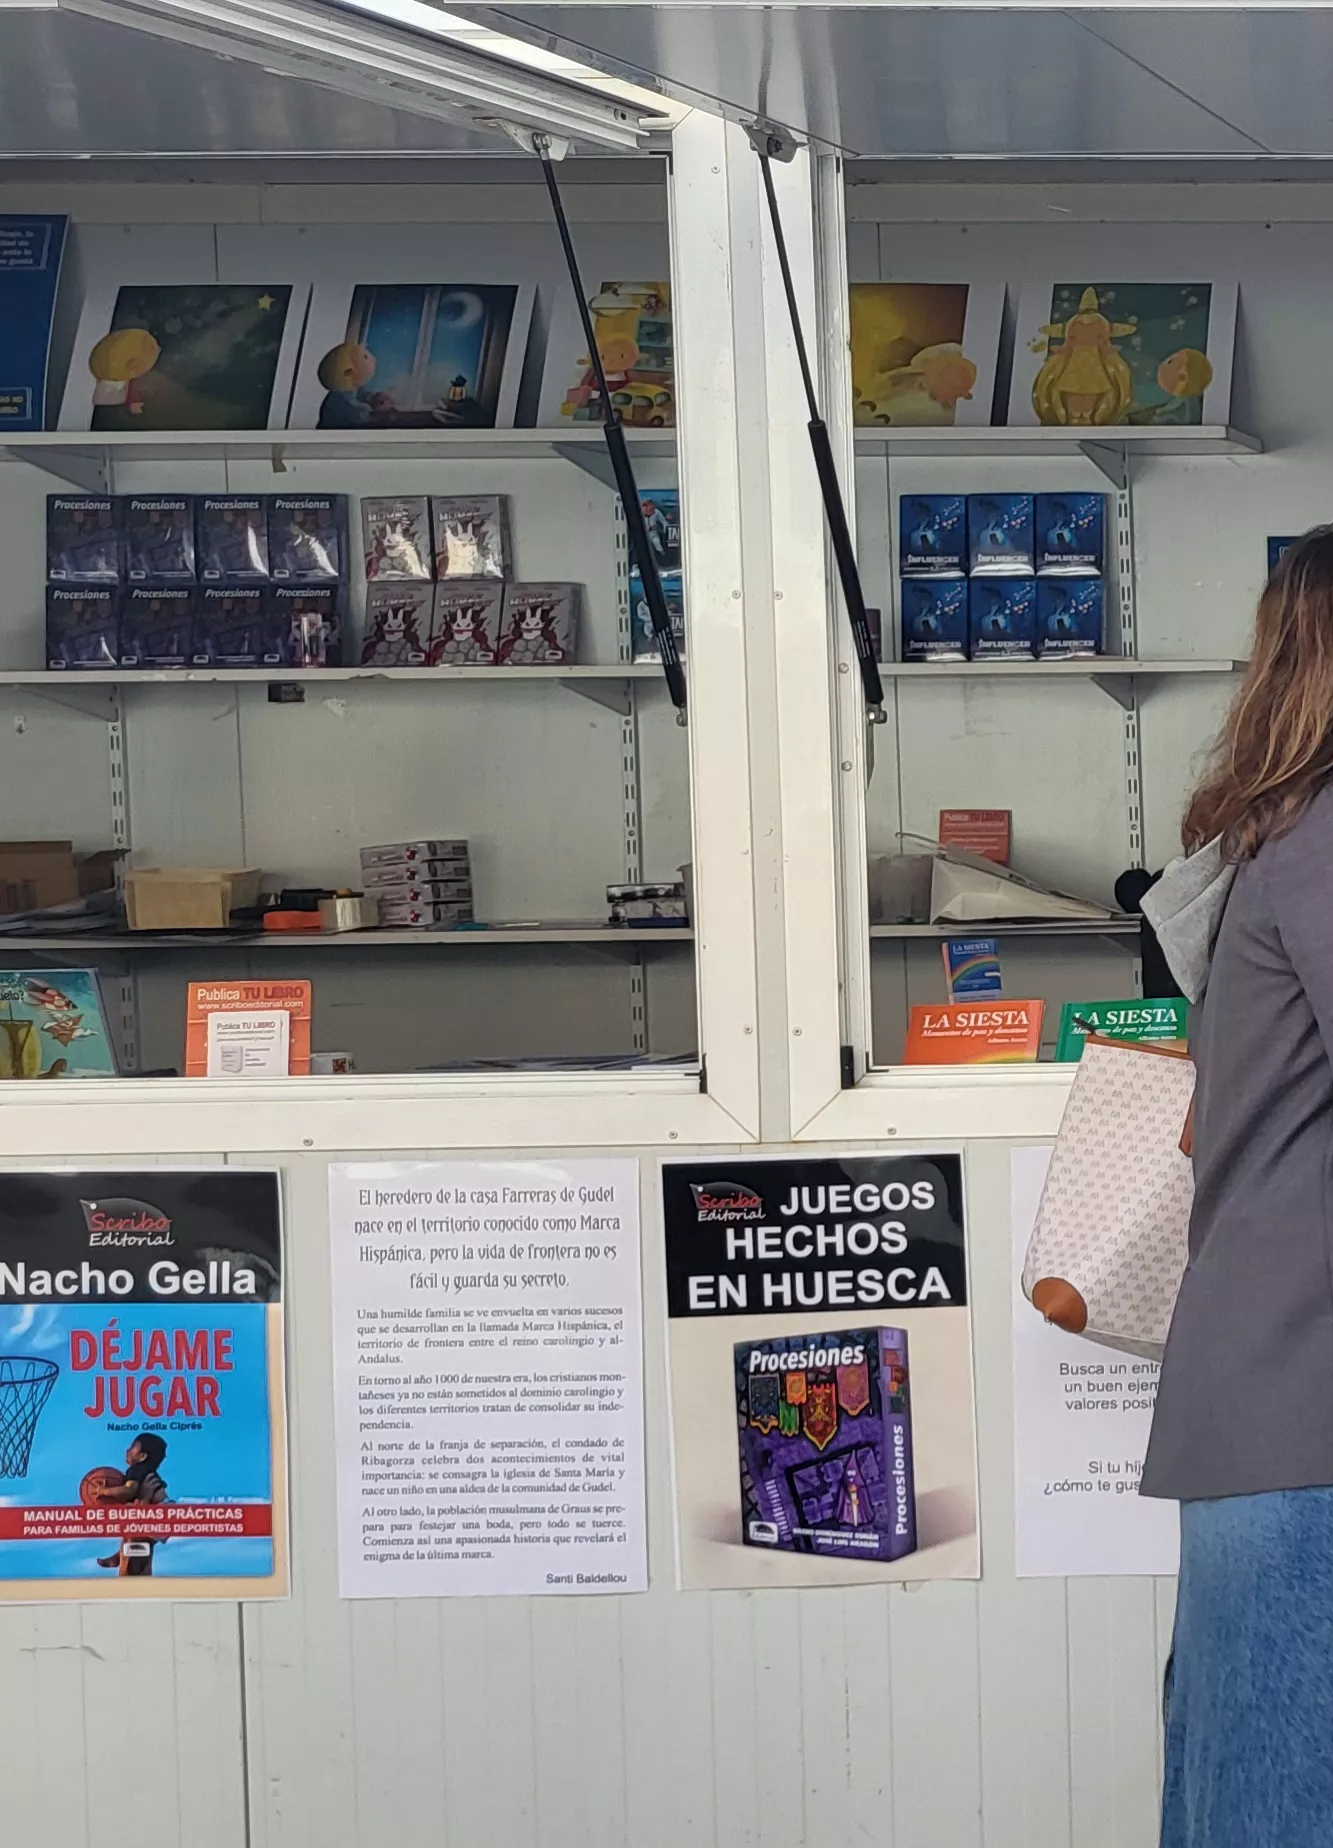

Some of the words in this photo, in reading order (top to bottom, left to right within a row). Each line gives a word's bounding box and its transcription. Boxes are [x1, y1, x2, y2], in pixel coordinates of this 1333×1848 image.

[54, 499, 111, 510] Procesiones
[131, 499, 186, 511] Procesiones
[204, 499, 259, 510] Procesiones
[275, 499, 330, 510] Procesiones
[53, 589, 111, 600] Procesiones
[132, 588, 188, 599] Procesiones
[205, 588, 260, 598] Procesiones
[276, 588, 330, 598] Procesiones
[197, 989, 240, 1000] Publica
[243, 987, 260, 999] TU
[264, 986, 305, 998] LIBRO
[923, 1014, 950, 1029] LA
[955, 1010, 1029, 1028] SIESTA
[1105, 1008, 1179, 1025] SIESTA
[359, 1190, 371, 1205] El
[375, 1189, 432, 1207] heredero
[436, 1188, 453, 1204] de
[455, 1188, 466, 1204] la
[468, 1191, 498, 1206] casa
[502, 1187, 556, 1205] Farreras
[558, 1187, 576, 1202] de
[578, 1186, 613, 1206] Gudel
[700, 1193, 762, 1209] Scribo
[780, 1181, 935, 1215] JUEGOS
[91, 1211, 172, 1231] Scribo
[697, 1210, 766, 1222] Editorial
[355, 1221, 383, 1236] nace
[387, 1221, 402, 1235] en
[406, 1217, 417, 1233] el
[422, 1216, 480, 1235] territorio
[484, 1215, 539, 1233] conocido
[542, 1218, 576, 1233] como
[581, 1215, 620, 1230] Marca
[89, 1232, 175, 1247] Editorial
[726, 1222, 908, 1260] HECHOS
[360, 1245, 426, 1264] Hispánica,
[430, 1248, 458, 1264] pero
[462, 1244, 474, 1260] la
[478, 1244, 505, 1260] vida
[509, 1244, 524, 1259] de
[528, 1243, 580, 1261] frontera
[585, 1246, 600, 1261] no
[604, 1246, 616, 1260] es
[0, 1262, 134, 1296] Nacho
[149, 1261, 256, 1295] Gella
[410, 1272, 437, 1289] fácil
[442, 1276, 449, 1293] y
[454, 1272, 499, 1293] guarda
[503, 1275, 517, 1290] su
[521, 1272, 569, 1289] secreto.
[688, 1274, 748, 1310] EN
[763, 1266, 951, 1307] HUESCA
[69, 1317, 234, 1371] DÉJAME
[749, 1343, 865, 1373] Procesiones
[1060, 1362, 1105, 1376] Busca
[1109, 1365, 1127, 1374] un
[1131, 1362, 1161, 1374] entr
[1064, 1383, 1082, 1393] un
[1087, 1380, 1123, 1393] buen
[84, 1375, 221, 1418] JUGAR
[1065, 1398, 1118, 1410] valores
[107, 1423, 139, 1432] Nacho
[141, 1422, 167, 1431] Gella
[170, 1421, 203, 1432] Ciprés
[1088, 1460, 1103, 1474] Si
[1107, 1460, 1120, 1473] tu
[1125, 1460, 1142, 1476] hij
[895, 1424, 907, 1536] Procesiones
[1043, 1479, 1093, 1496] ¿cómo
[1098, 1480, 1110, 1491] te
[23, 1510, 82, 1522] MANUAL
[86, 1509, 103, 1521] DE
[108, 1508, 164, 1520] BUENAS
[167, 1505, 243, 1519] PRÁCTICAS
[23, 1525, 52, 1536] PARA
[55, 1525, 104, 1534] FAMILIAS
[107, 1524, 121, 1533] DE
[123, 1522, 171, 1533] JÓVENES
[174, 1523, 243, 1533] DEPORTISTAS
[547, 1573, 573, 1584] Santi
